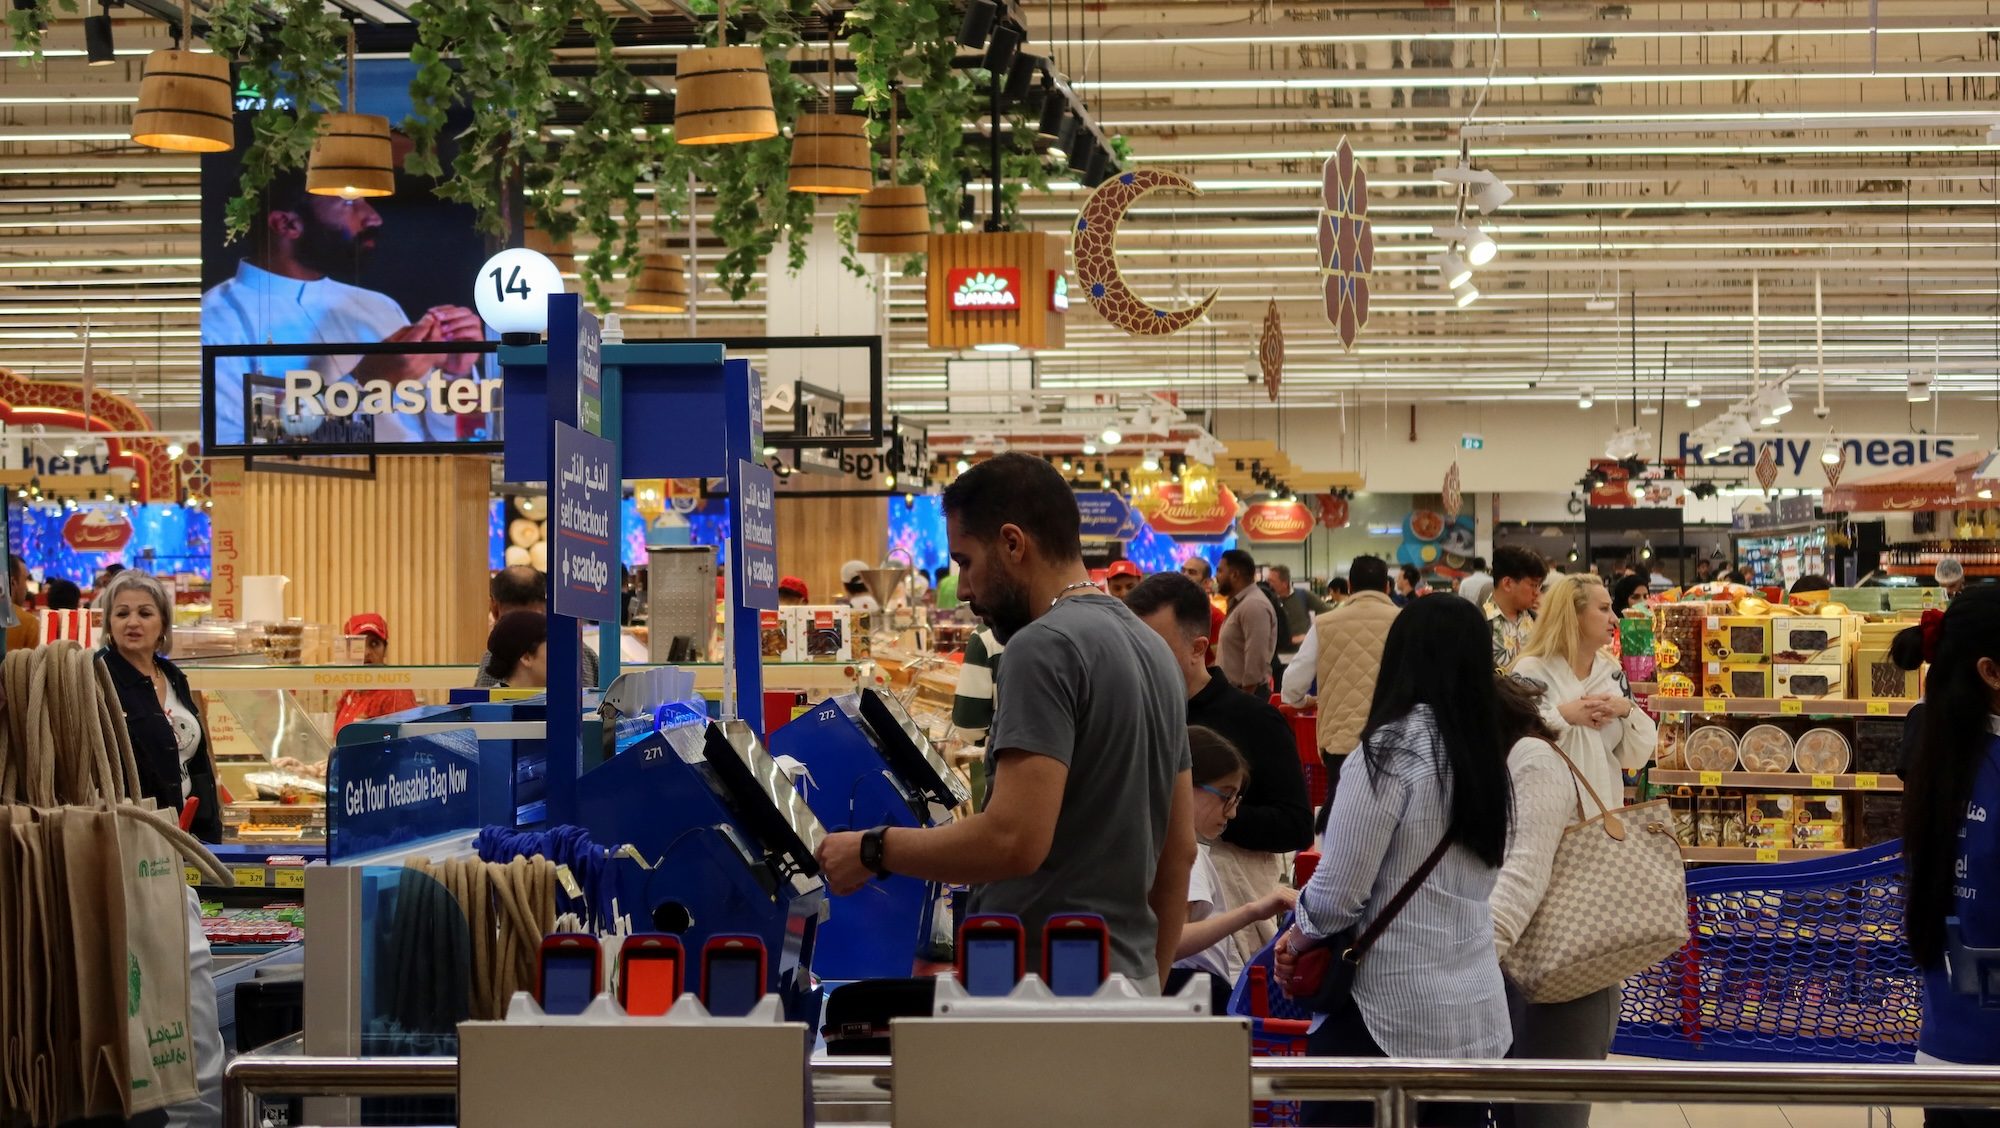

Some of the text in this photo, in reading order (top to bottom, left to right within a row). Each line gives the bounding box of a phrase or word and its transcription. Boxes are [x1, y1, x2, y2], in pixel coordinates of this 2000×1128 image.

[489, 265, 532, 302] 14
[560, 452, 609, 501] الدفع الذاتي
[560, 497, 609, 538] self checkout
[1151, 498, 1226, 525] Ramaan
[752, 518, 773, 546] checkout
[571, 551, 608, 593] scan&go
[752, 556, 774, 588] scan&go
[313, 672, 412, 684] ROASTED NUTS
[818, 709, 836, 722] 272
[643, 746, 663, 761] 271
[345, 762, 468, 817] Get Your Reusable Bag Now
[186, 873, 199, 881] 3.29
[249, 874, 263, 882] 3.79
[289, 875, 304, 883] 9.49
